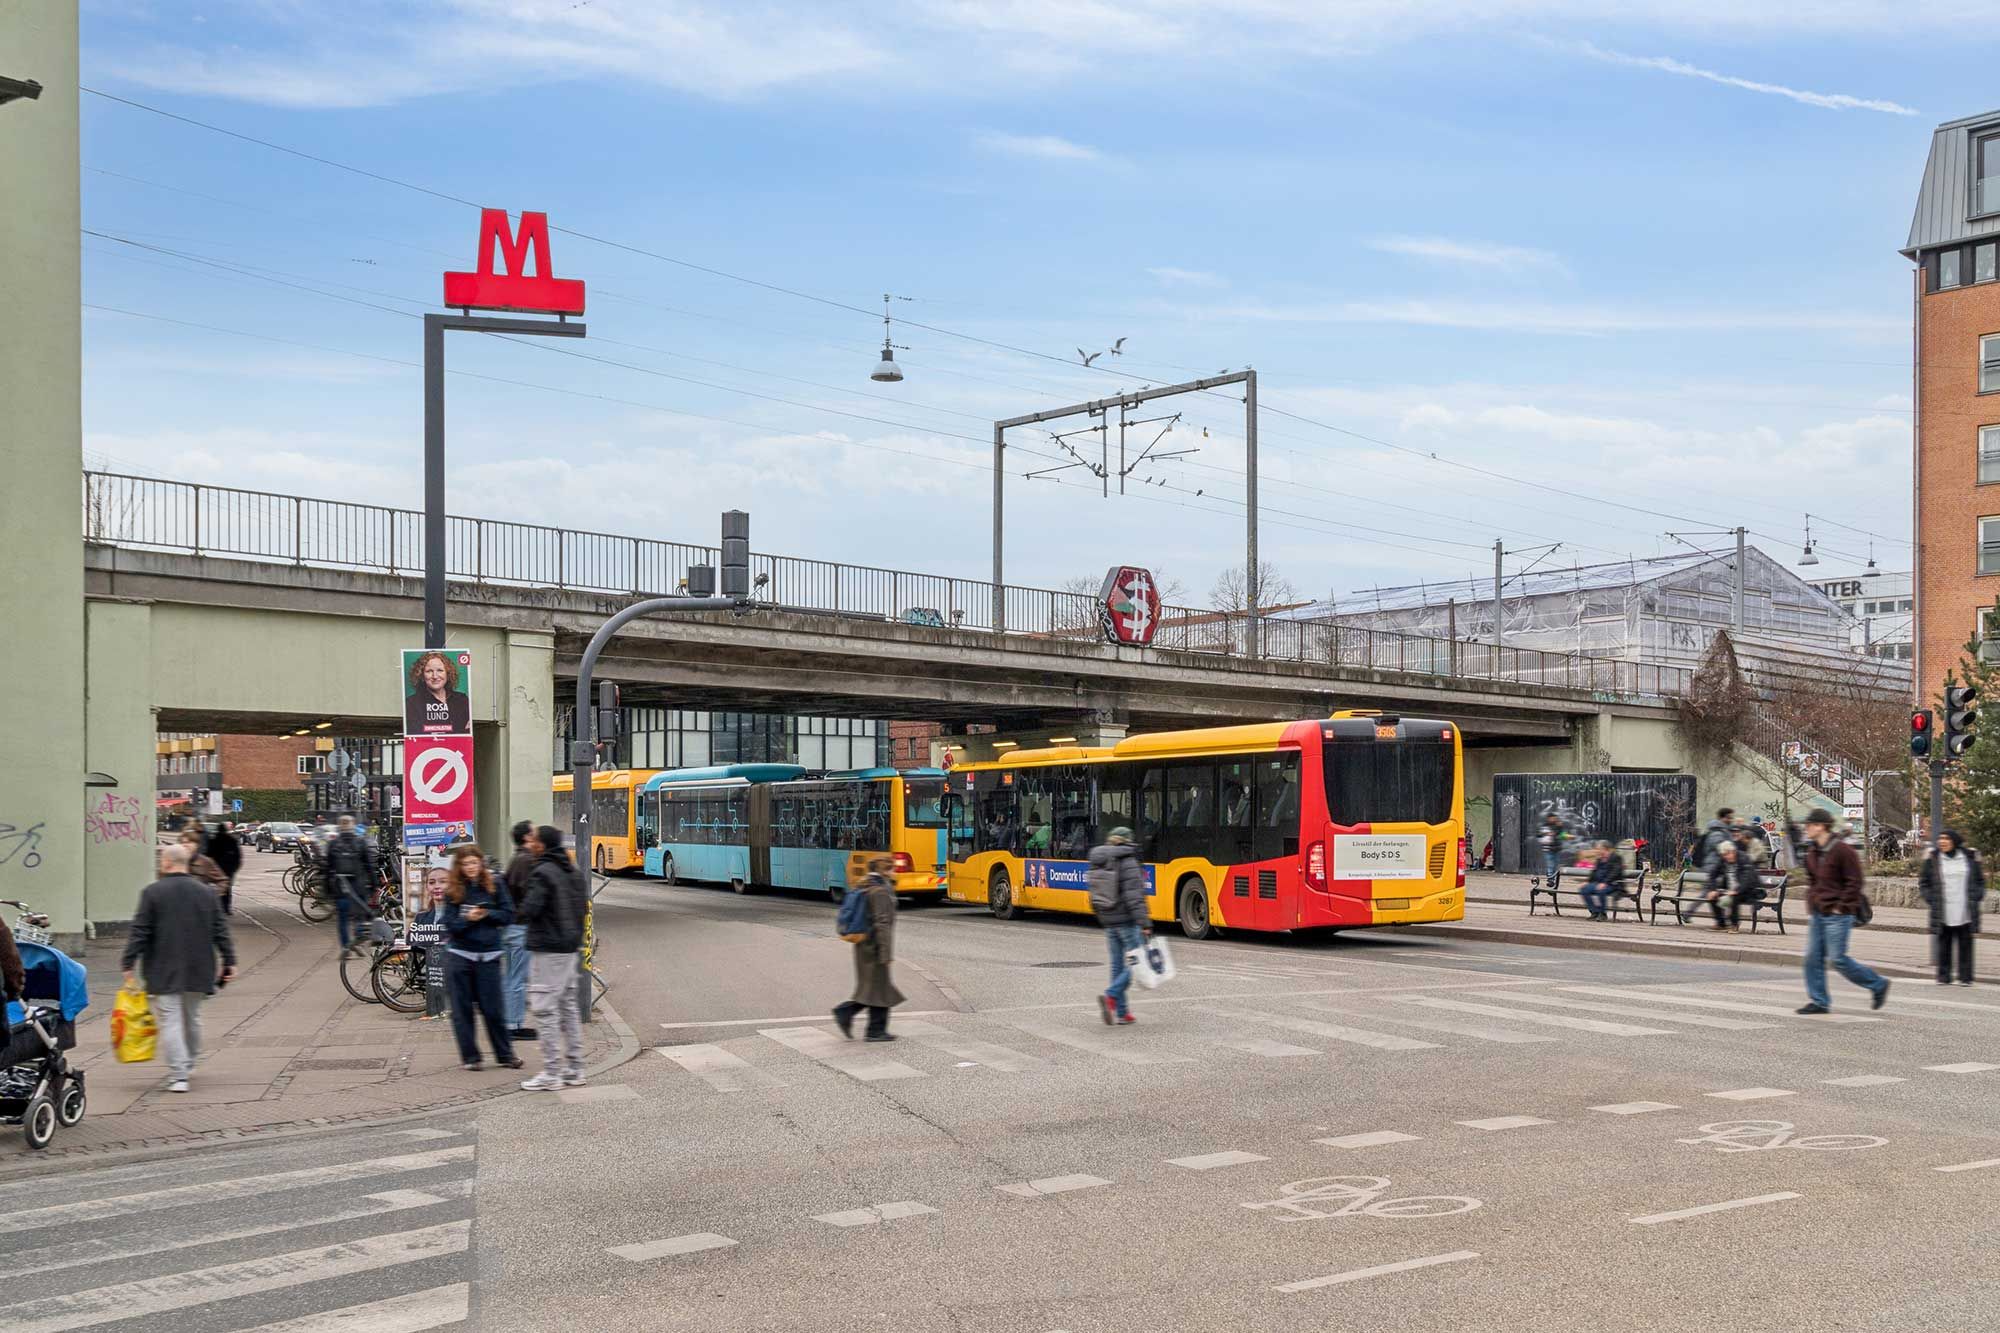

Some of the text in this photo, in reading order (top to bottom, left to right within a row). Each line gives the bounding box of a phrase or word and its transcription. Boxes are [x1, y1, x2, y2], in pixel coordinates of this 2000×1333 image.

[1807, 580, 1863, 598] NTER
[426, 703, 449, 712] ROSA
[426, 712, 449, 720] LUND
[1361, 850, 1380, 860] Body
[1050, 869, 1078, 882] Danmark
[409, 933, 440, 942] Nawa
